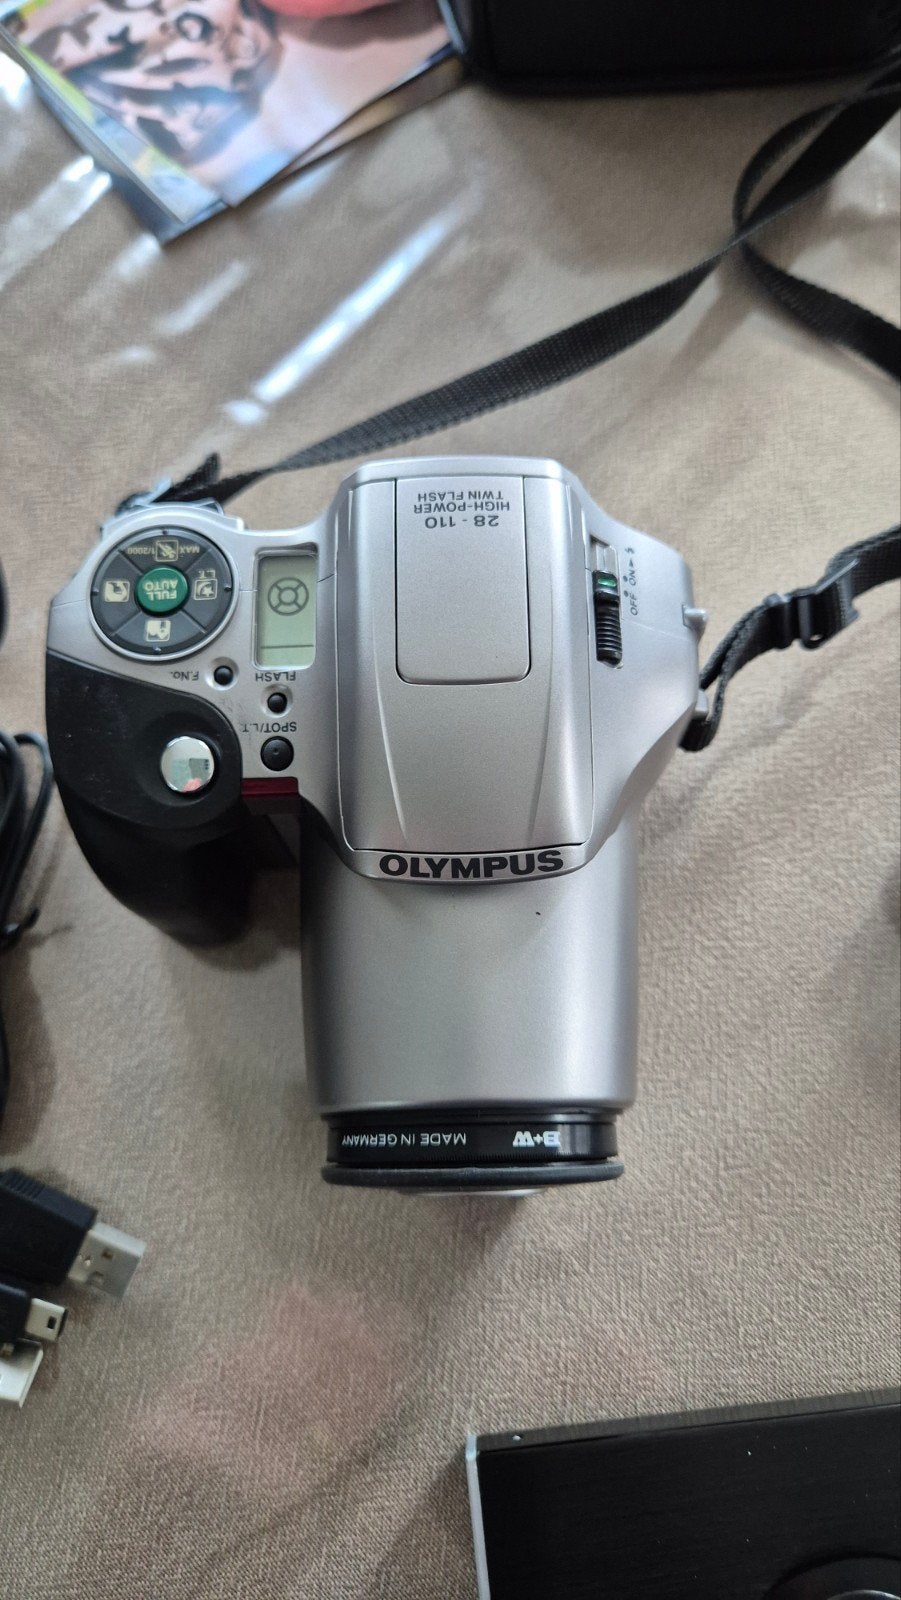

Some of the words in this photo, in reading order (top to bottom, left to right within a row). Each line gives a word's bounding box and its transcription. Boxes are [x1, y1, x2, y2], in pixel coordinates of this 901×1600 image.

[418, 491, 464, 502] FLASH
[468, 490, 503, 500] TWIN
[414, 501, 510, 514] HIGH-POWER
[425, 516, 456, 529] 110
[474, 515, 499, 527] 28
[127, 546, 156, 555] 1/2000
[179, 545, 200, 554] MAX
[628, 570, 637, 586] ON
[143, 578, 179, 592] AUTO
[148, 590, 177, 602] FULL
[630, 593, 638, 616] OFF
[170, 671, 200, 681] F.No.
[255, 671, 296, 682] FLASH
[379, 849, 564, 879] OLYMPUS
[341, 1133, 398, 1146] GERMANY
[400, 1133, 416, 1147] IN
[420, 1133, 467, 1147] MADE
[512, 1130, 562, 1148] B+W
